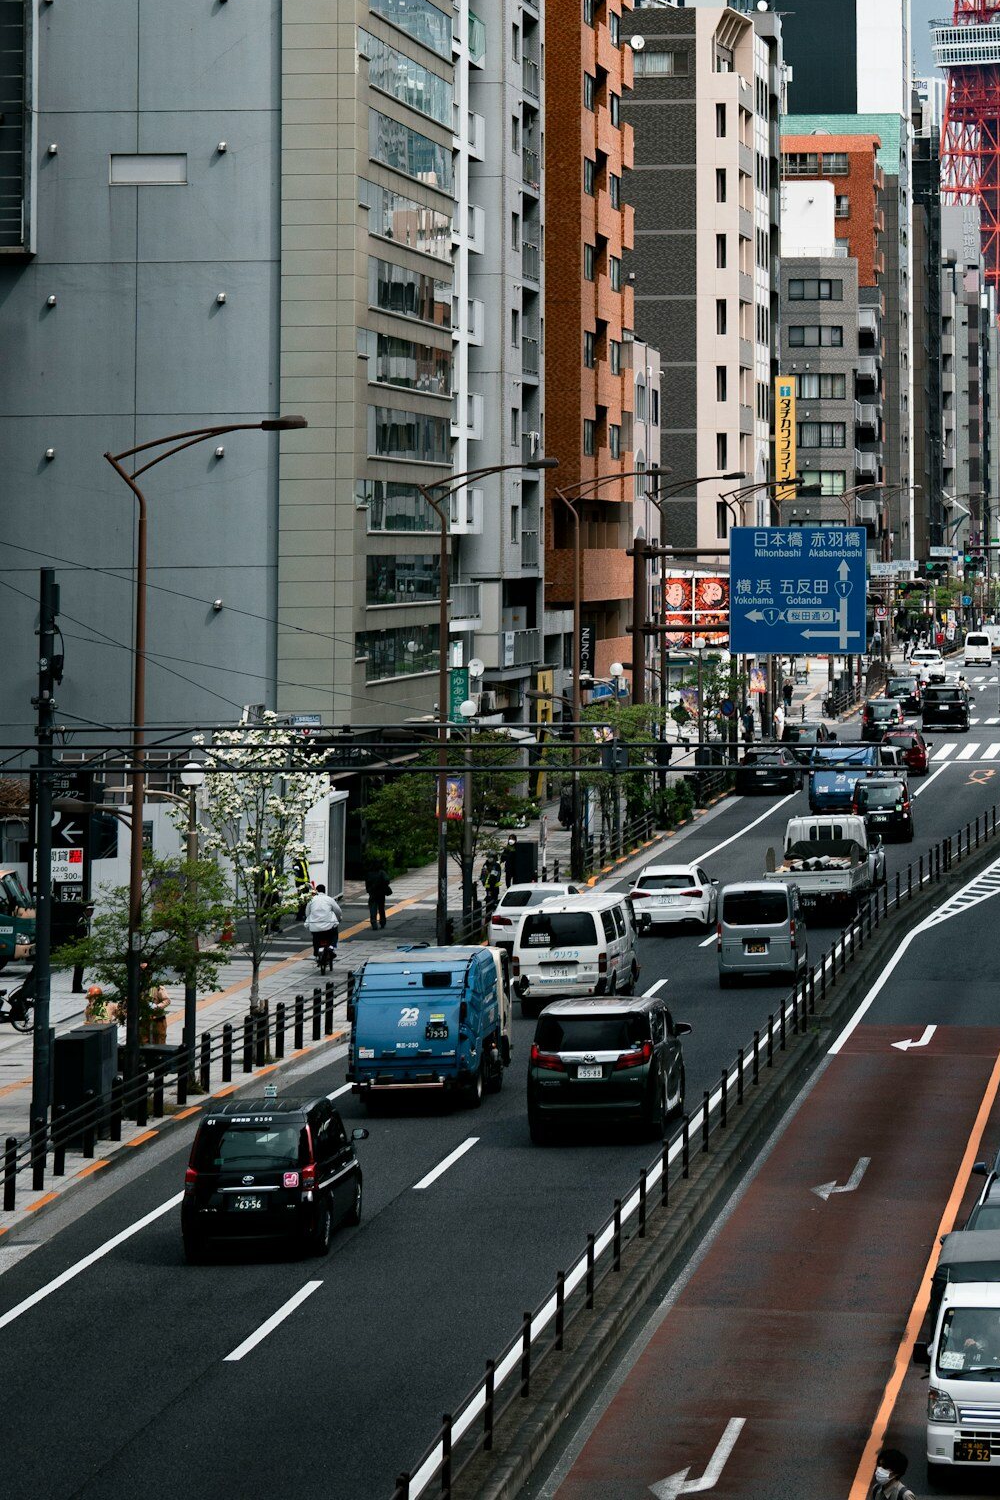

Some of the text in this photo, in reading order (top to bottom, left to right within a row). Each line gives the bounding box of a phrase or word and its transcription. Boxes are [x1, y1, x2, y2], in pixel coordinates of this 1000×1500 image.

[754, 532, 860, 547] 日本橋 赤羽橋
[754, 549, 862, 557] Nihonbashi Akabanebashi
[736, 579, 828, 594] 横浜 五反田
[841, 583, 846, 593] 1
[734, 596, 822, 605] Yokohama Gotanda
[768, 611, 773, 620] 1
[791, 611, 831, 620] 桜田通り
[581, 627, 590, 660] NUNC
[400, 1007, 419, 1022] 23
[398, 1020, 417, 1028] TOKYO
[239, 1200, 261, 1209] 63-56
